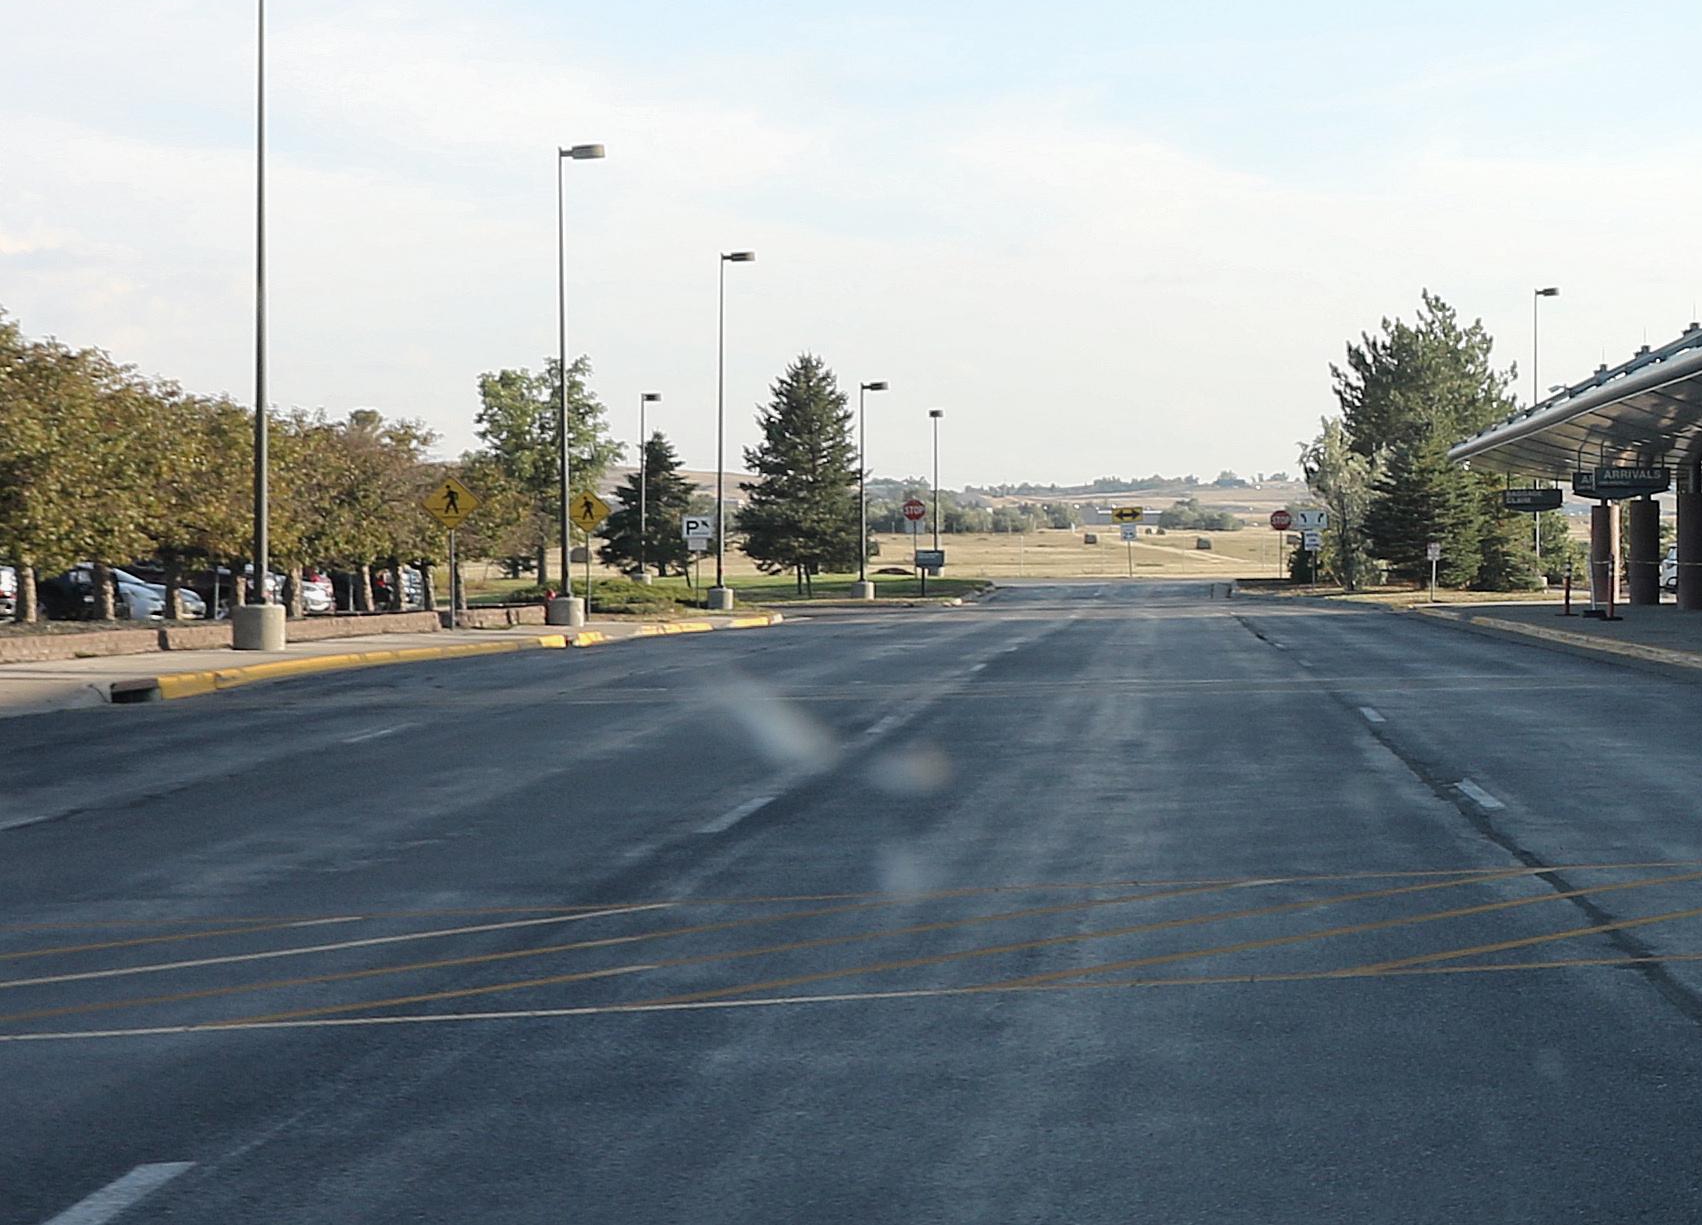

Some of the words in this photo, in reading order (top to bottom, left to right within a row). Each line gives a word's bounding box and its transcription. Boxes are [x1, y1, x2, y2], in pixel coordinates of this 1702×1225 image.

[1603, 469, 1662, 479] ARRIVALS
[904, 505, 925, 513] STOP
[1271, 515, 1291, 524] STOP
[686, 521, 699, 535] P
